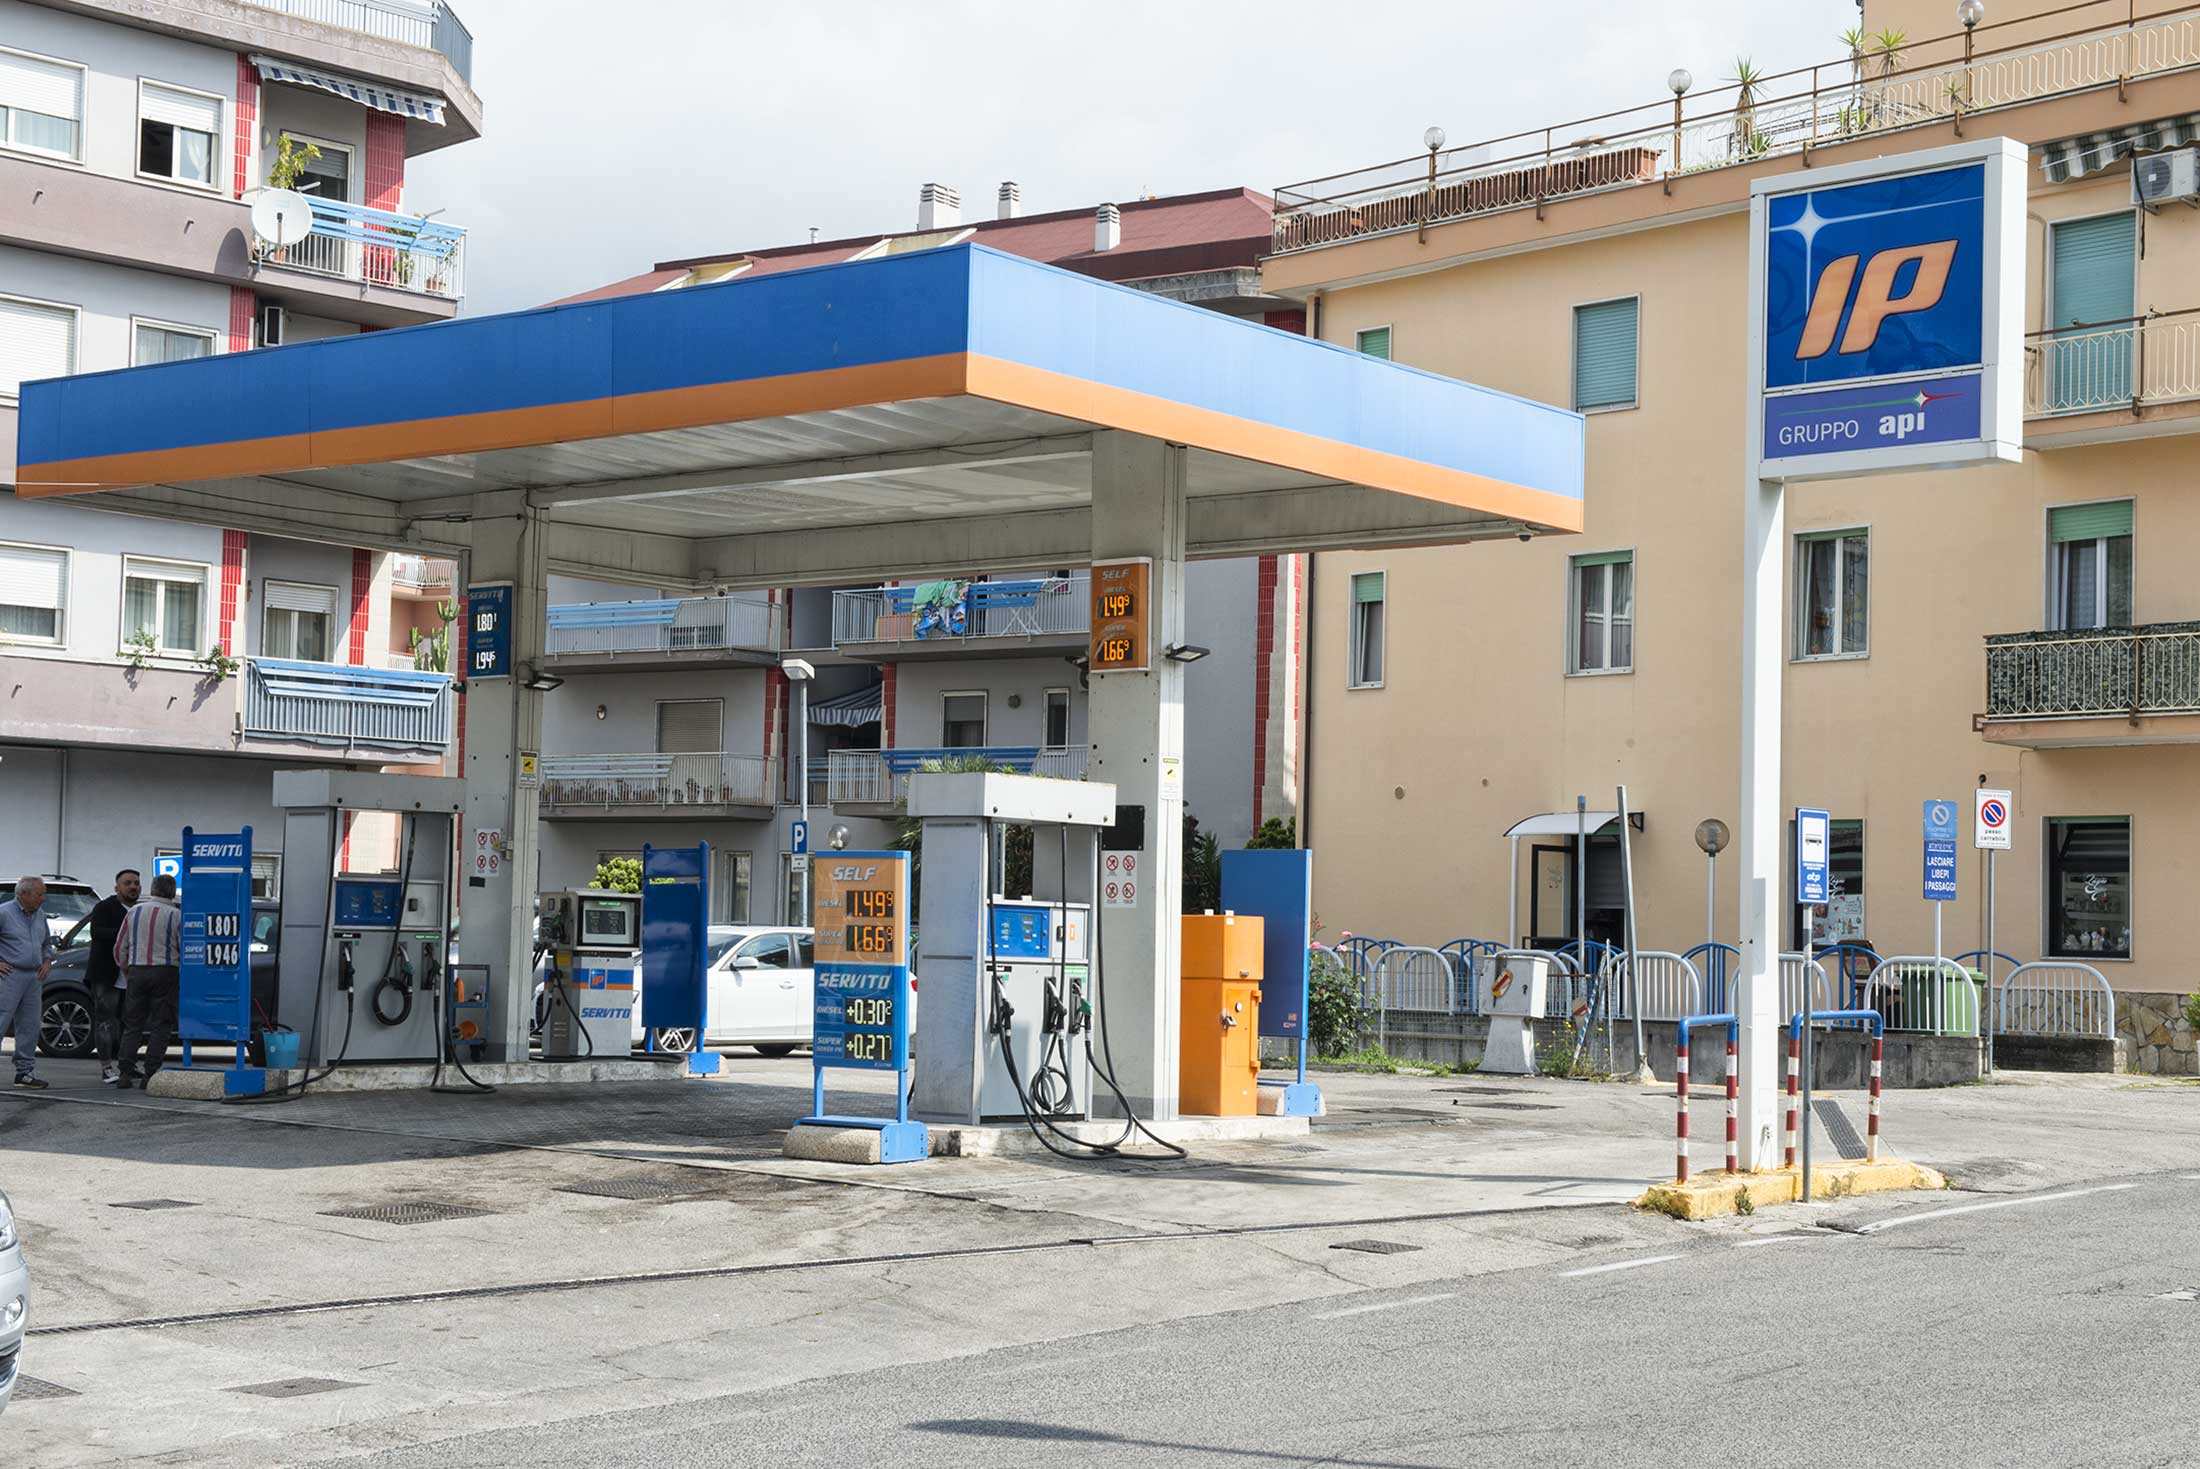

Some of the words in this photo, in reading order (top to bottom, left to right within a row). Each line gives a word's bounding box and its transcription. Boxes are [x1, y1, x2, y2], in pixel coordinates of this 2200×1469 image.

[1794, 238, 1960, 361] IP
[1779, 419, 1859, 445] GRUPPO
[1879, 411, 1925, 440] api
[1102, 568, 1129, 579] SELF
[794, 824, 805, 852] P
[192, 845, 243, 857] SERVITO
[1927, 856, 1955, 867] LASCIARE
[832, 866, 878, 881] SELF
[818, 973, 891, 990] SERVITO
[581, 1007, 631, 1019] SERVITO
[816, 1006, 844, 1014] DIESEL
[817, 1036, 842, 1045] SUPER
